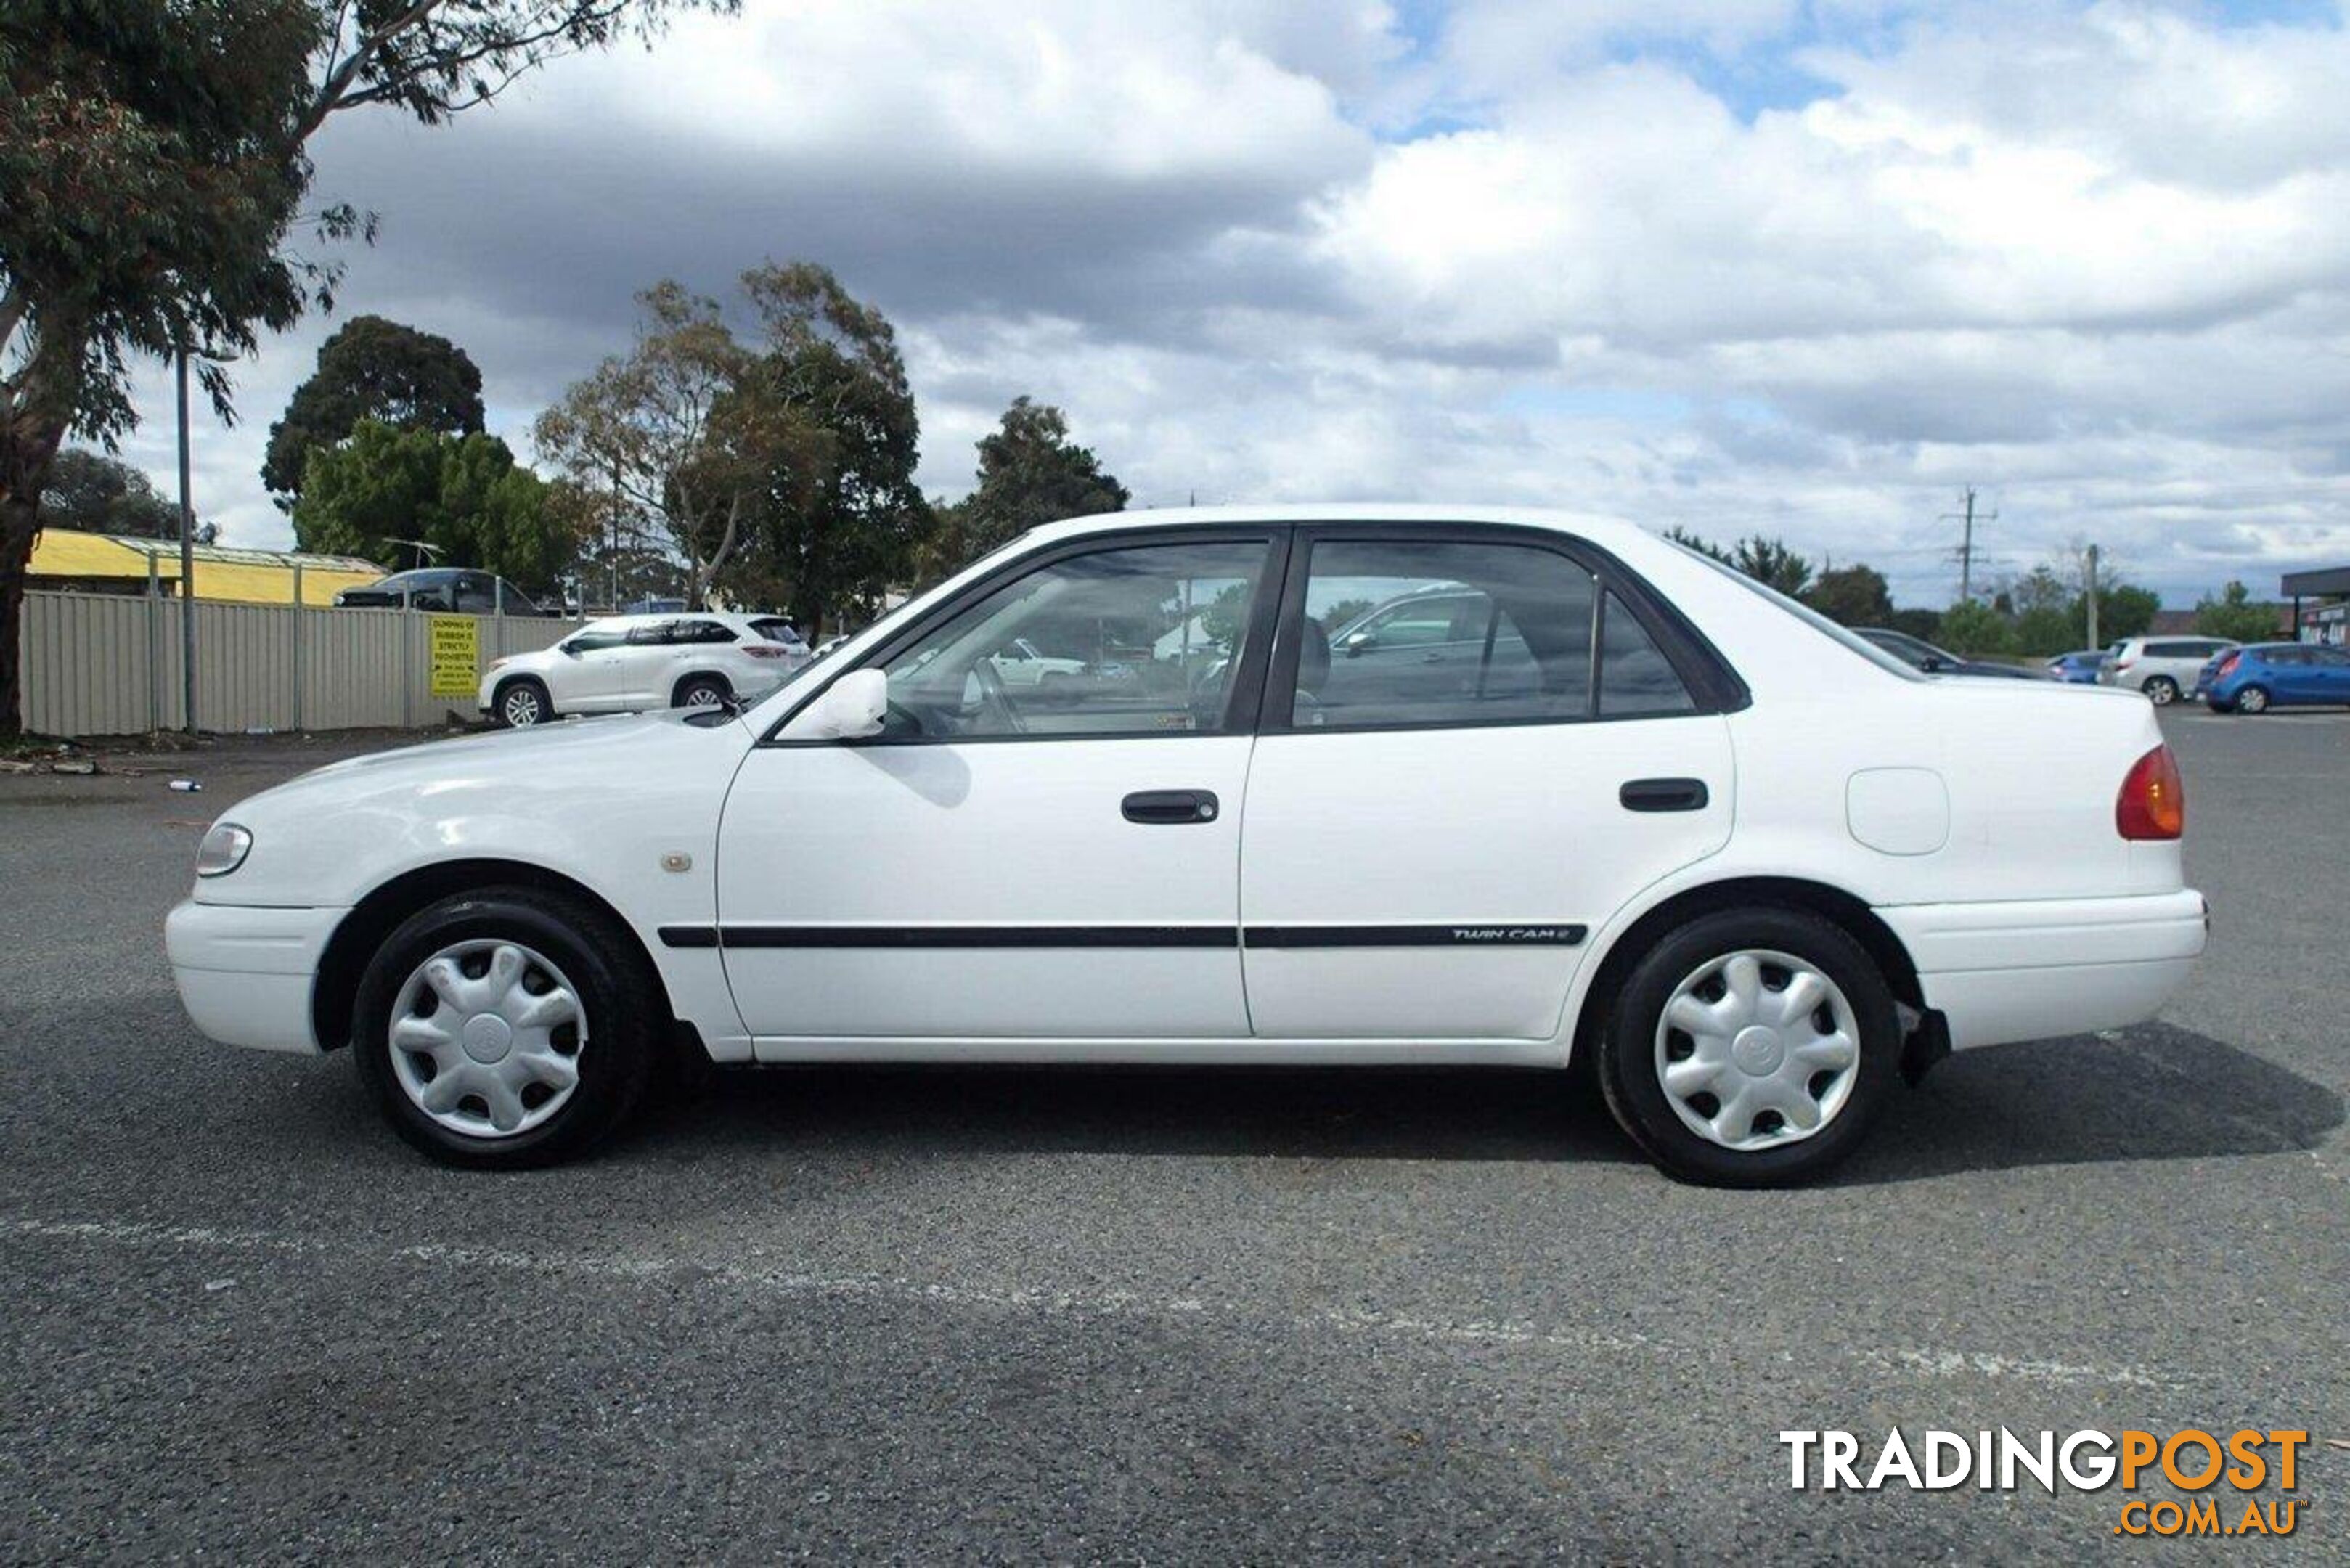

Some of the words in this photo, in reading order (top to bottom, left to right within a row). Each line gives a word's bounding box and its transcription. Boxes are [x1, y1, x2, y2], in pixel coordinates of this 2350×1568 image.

[439, 642, 470, 651] STRICTLY
[1453, 928, 1504, 939] TWIN
[1508, 928, 1554, 939] CAM
